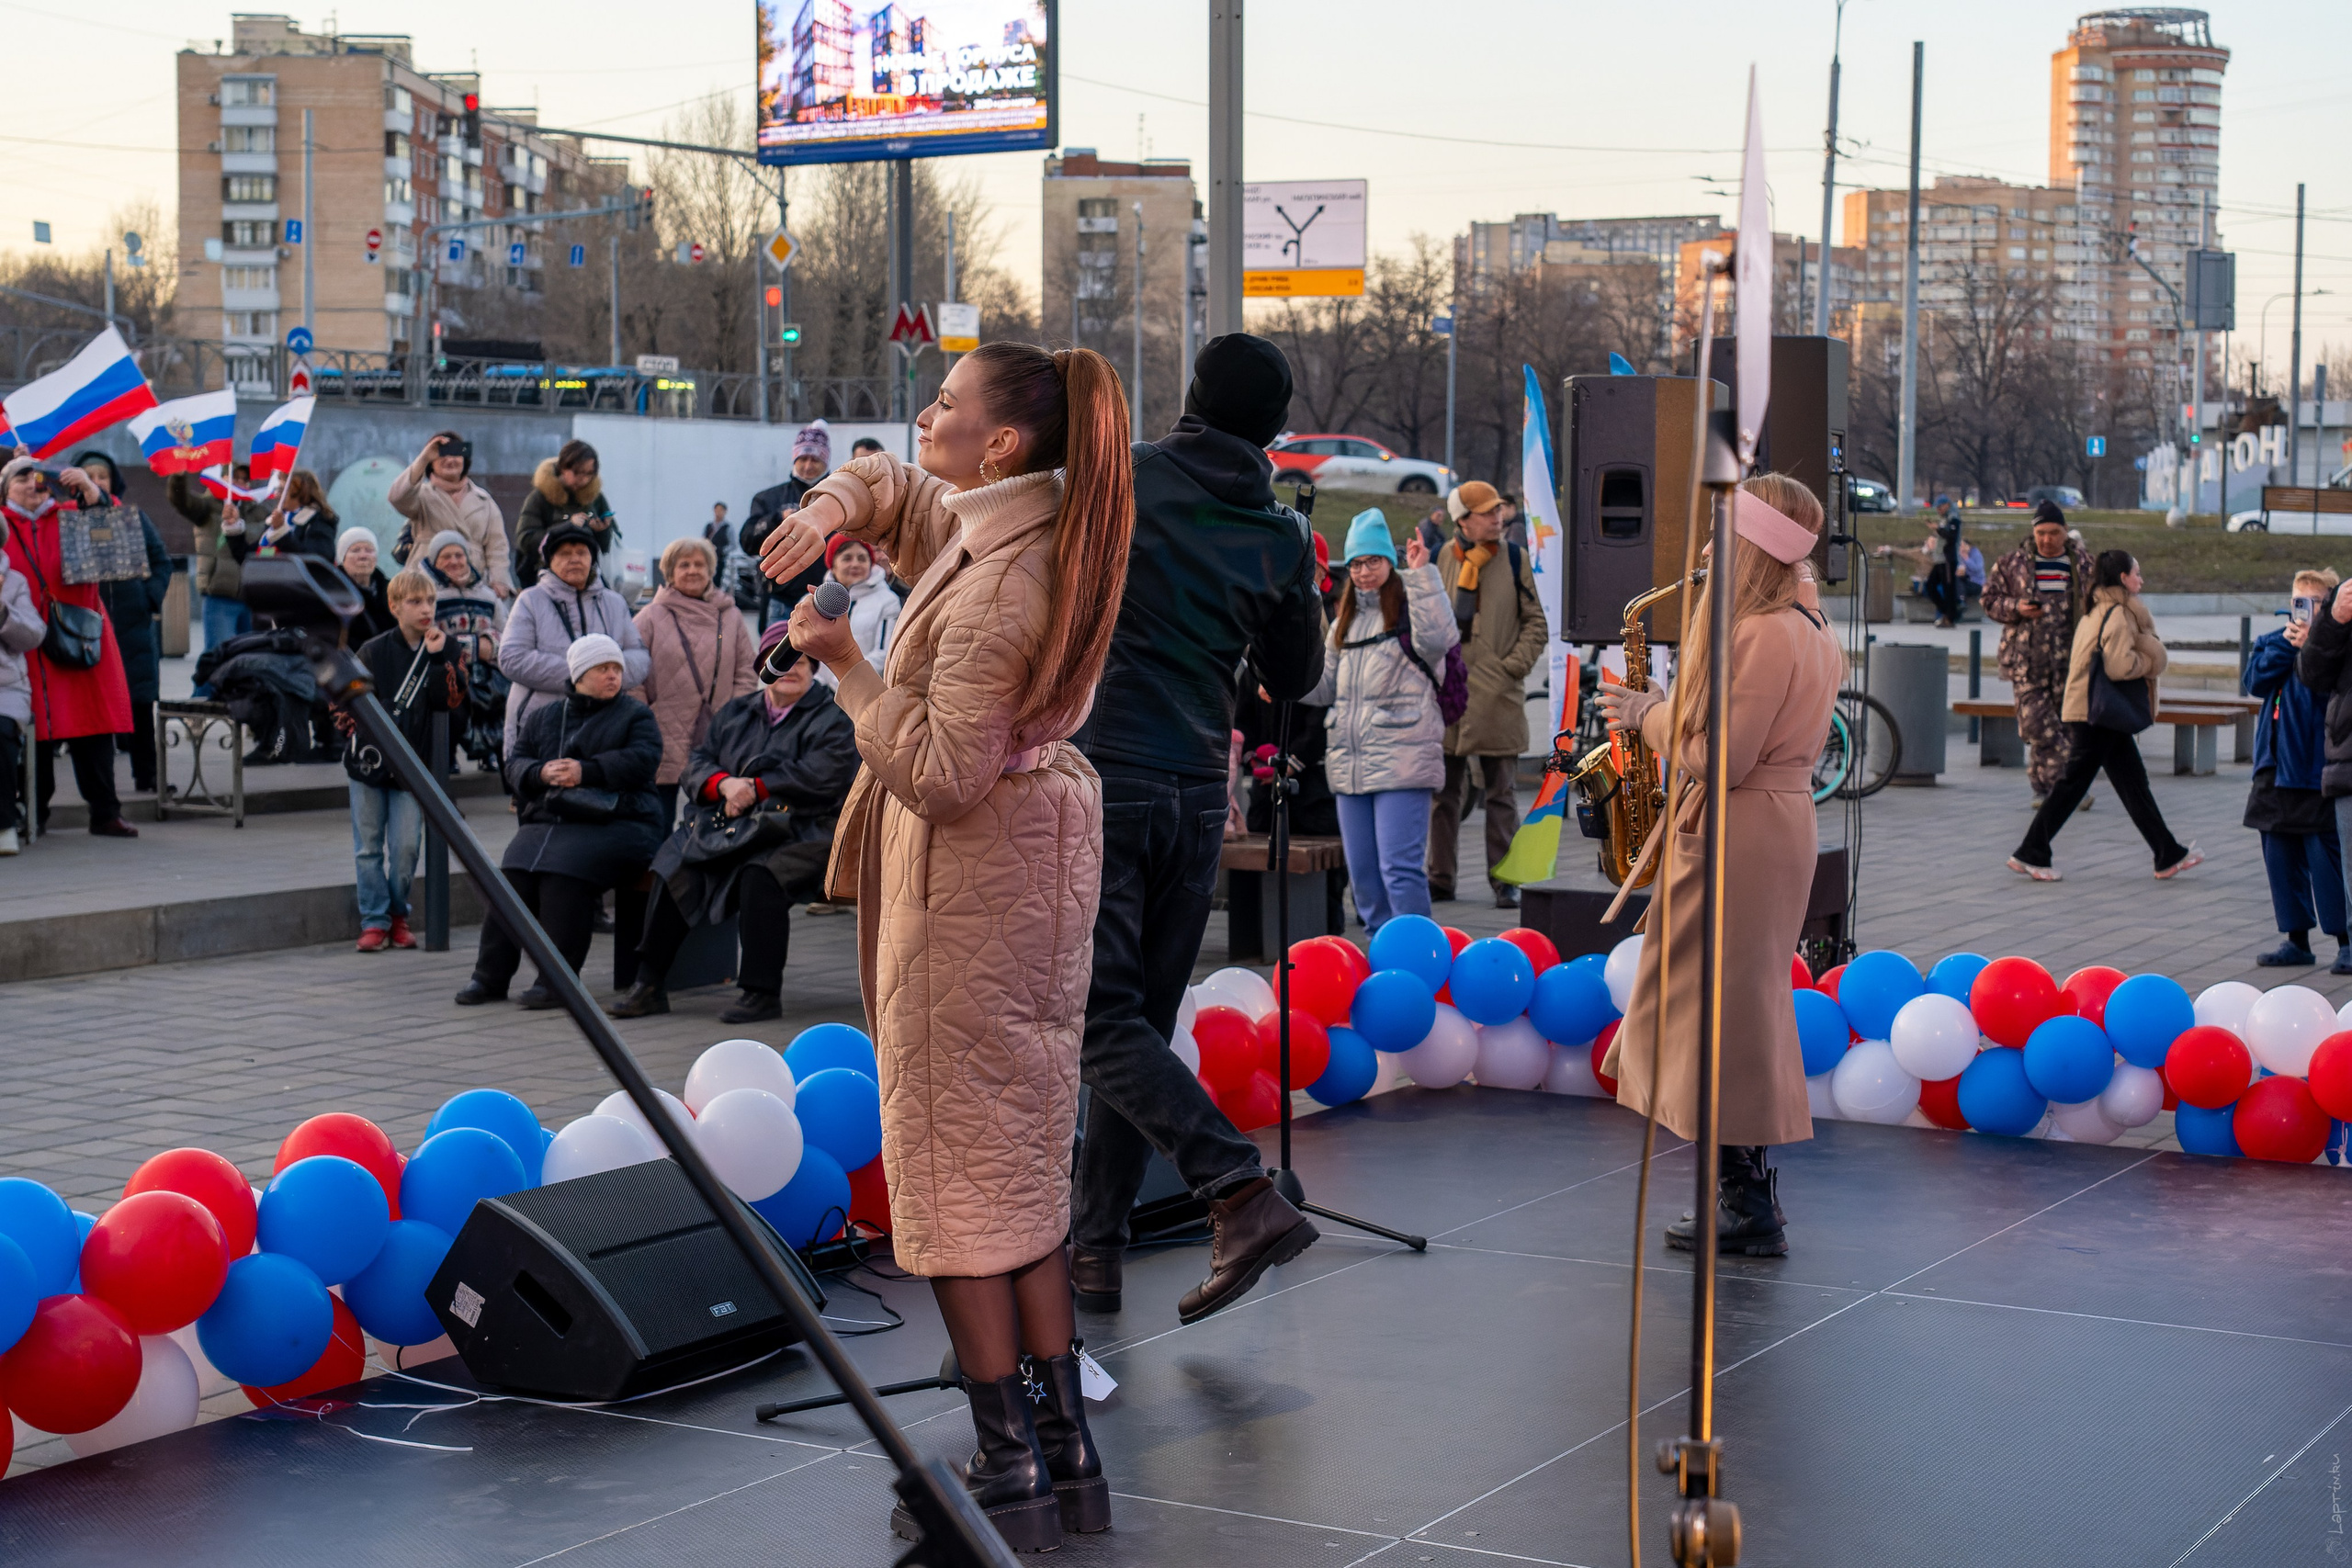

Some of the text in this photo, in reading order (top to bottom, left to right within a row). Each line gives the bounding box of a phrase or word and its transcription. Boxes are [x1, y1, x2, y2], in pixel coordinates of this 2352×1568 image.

[874, 50, 944, 73] НОВЫЕ
[899, 65, 1036, 96] В ПРОДАЖЕ
[713, 1303, 731, 1314] FBT
